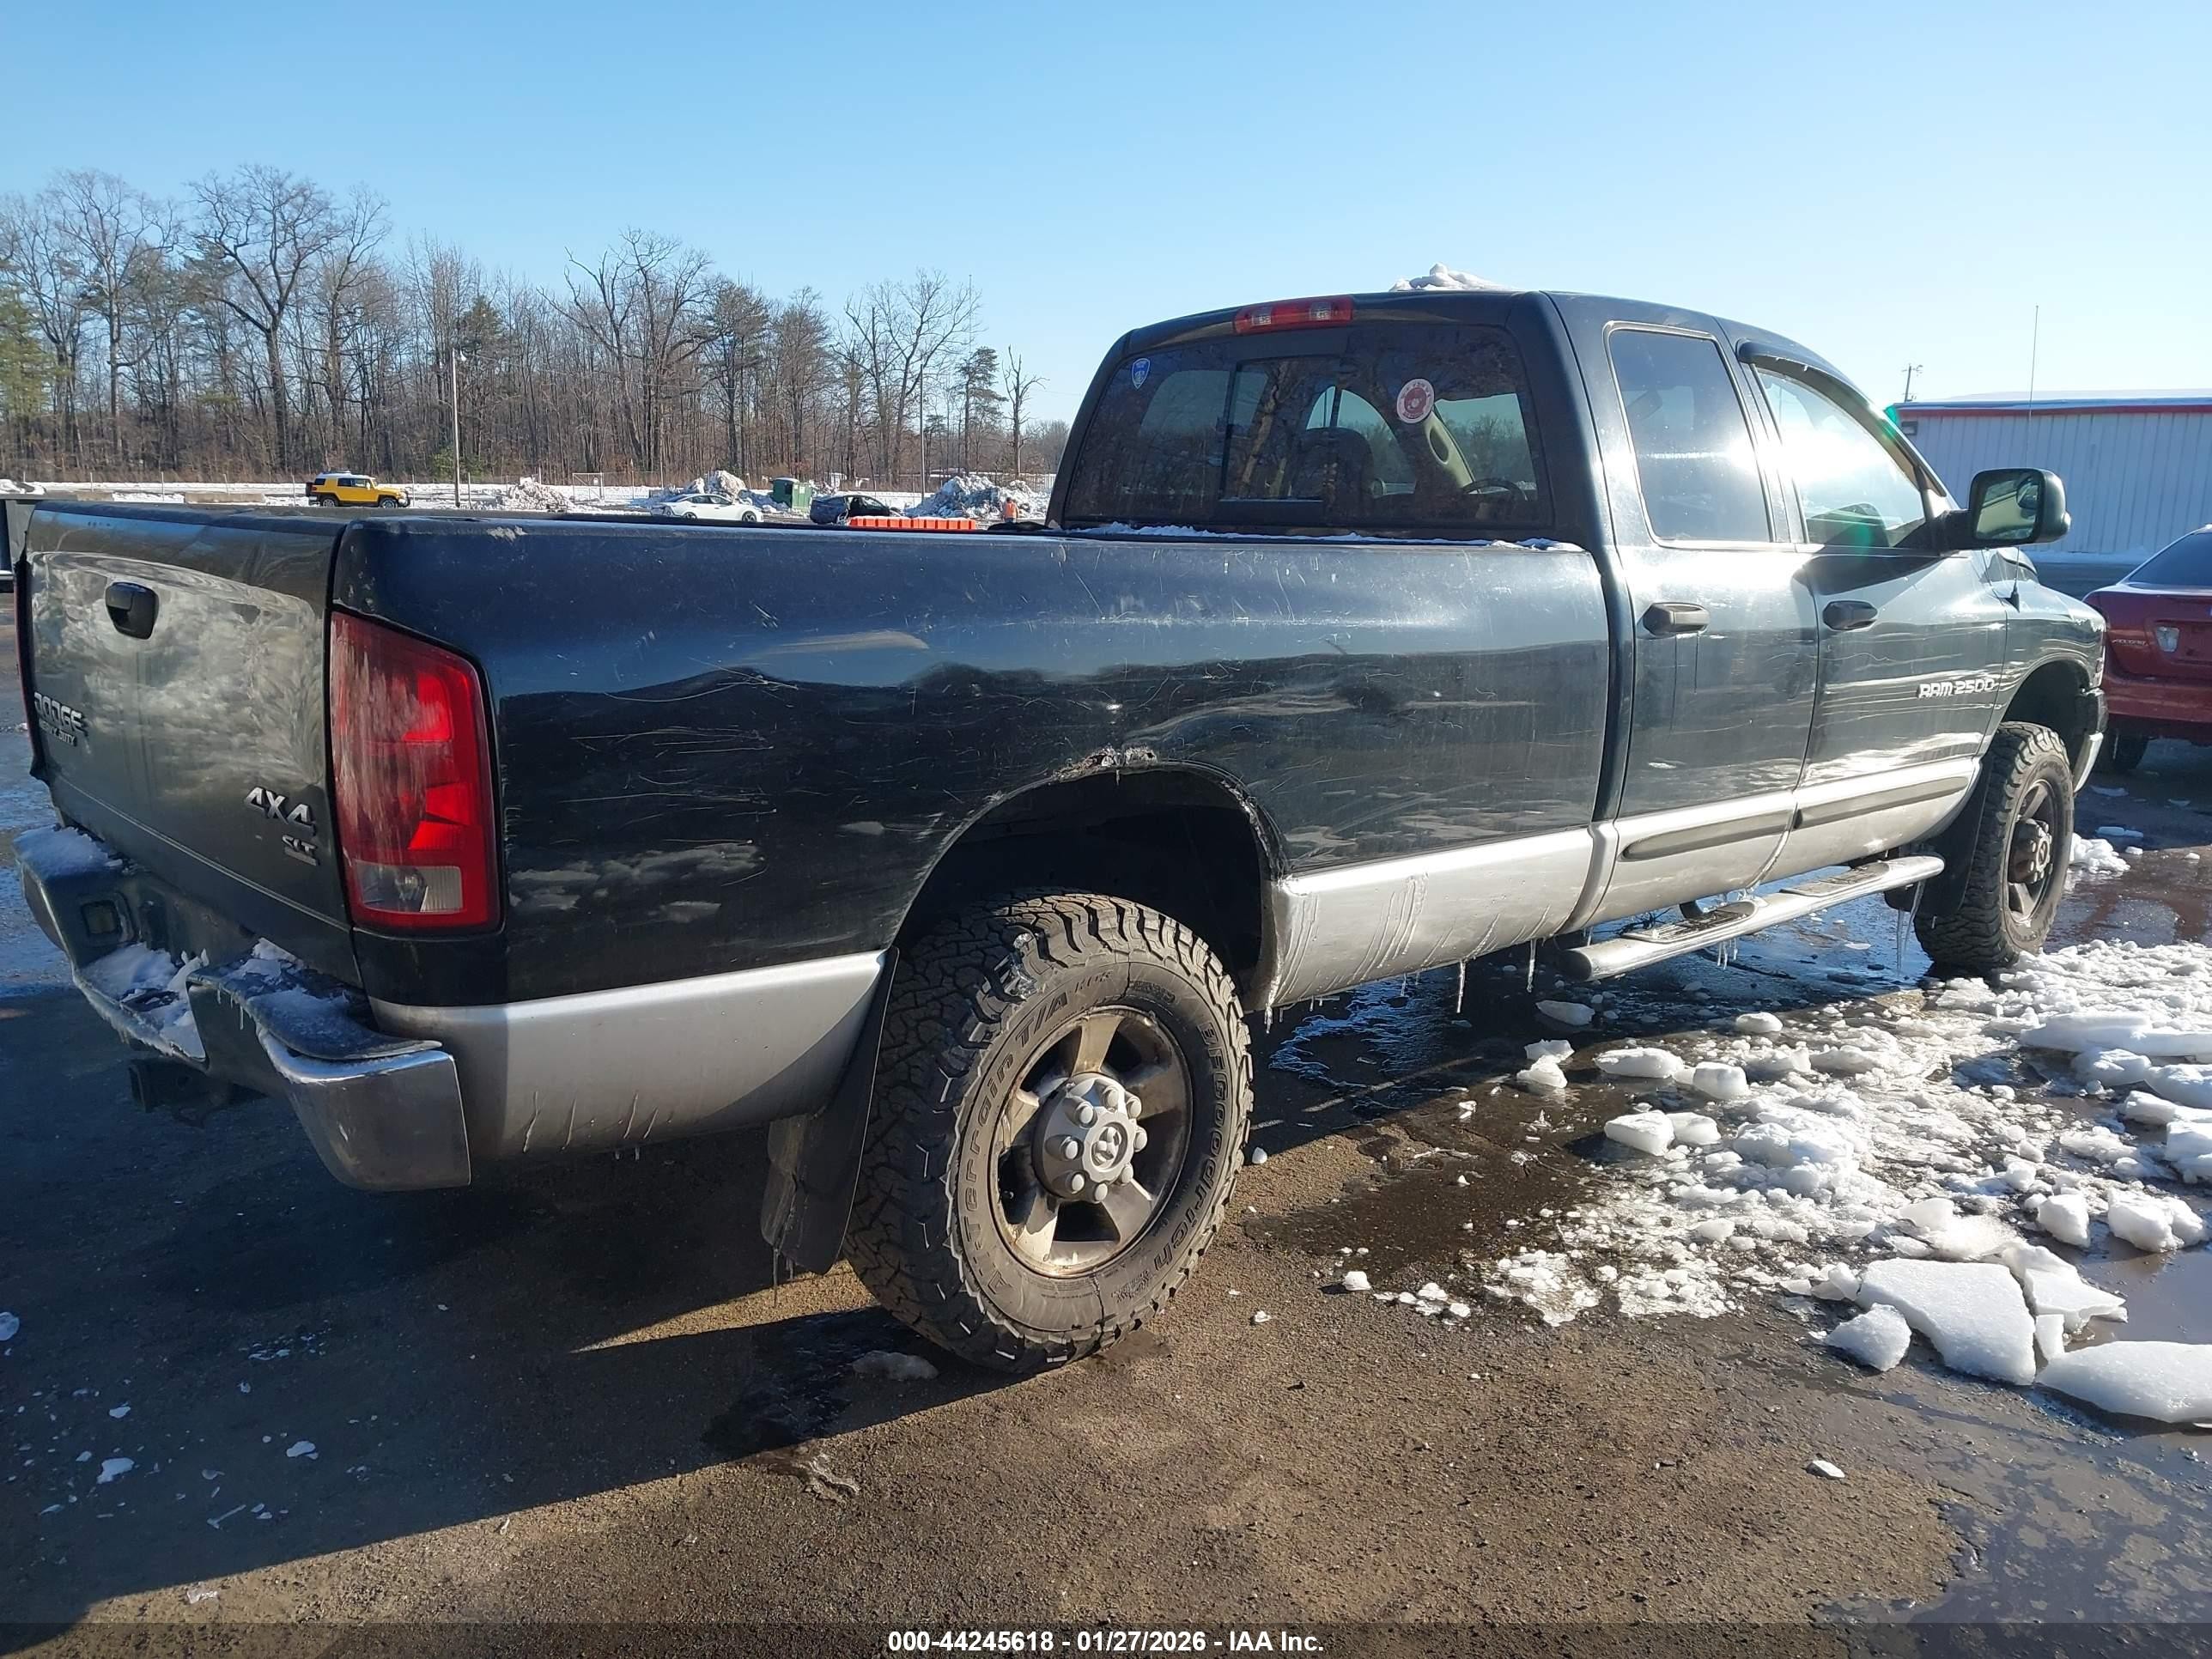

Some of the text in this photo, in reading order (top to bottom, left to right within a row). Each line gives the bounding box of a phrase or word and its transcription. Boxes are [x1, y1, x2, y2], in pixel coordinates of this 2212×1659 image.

[1918, 678, 1995, 698] RAM 2500
[34, 691, 83, 733] DODGE
[1014, 992, 1067, 1048] T/A
